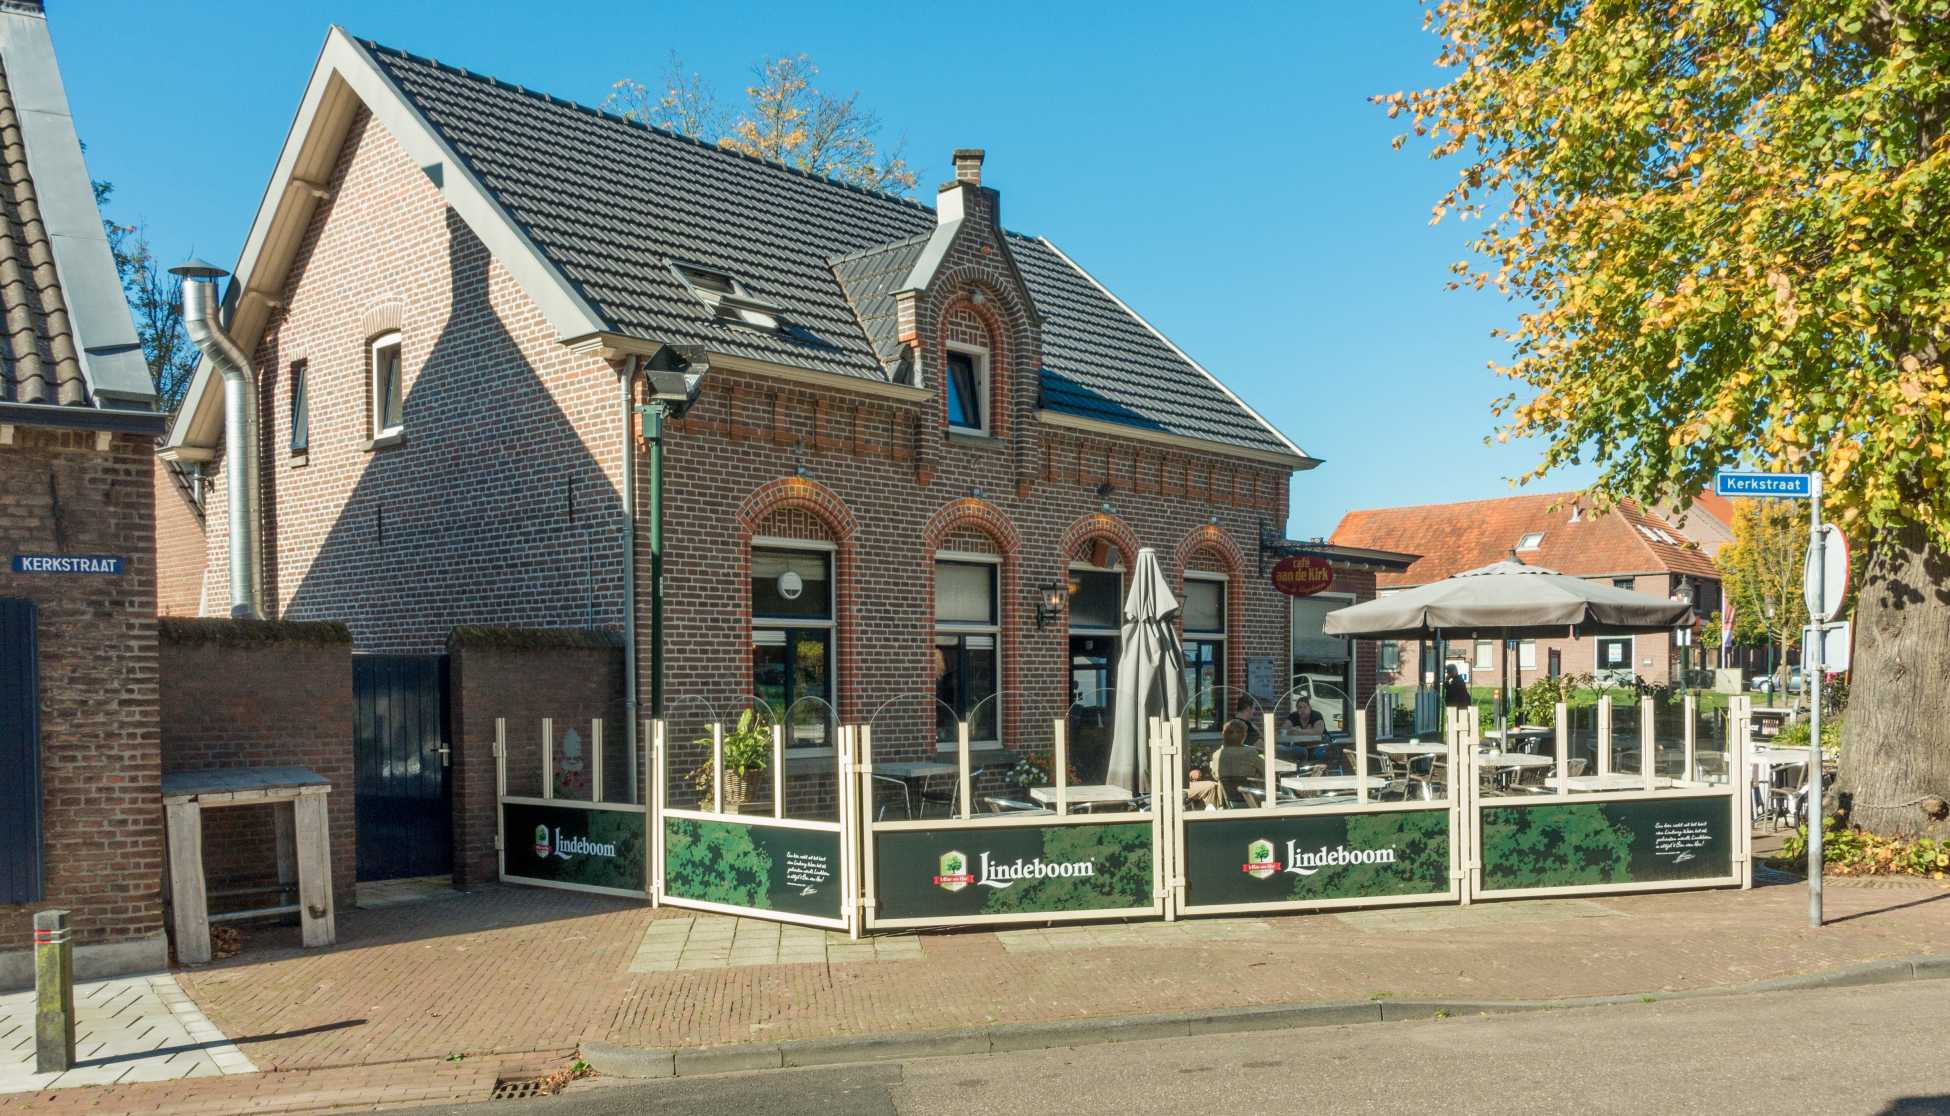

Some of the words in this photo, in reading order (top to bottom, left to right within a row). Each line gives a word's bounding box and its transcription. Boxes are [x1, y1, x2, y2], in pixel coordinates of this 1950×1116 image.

[1727, 477, 1801, 491] Kerkstraat
[22, 557, 117, 572] KERKSTRAAT
[1295, 568, 1307, 581] de
[554, 826, 617, 860] Lindeboom
[1284, 839, 1396, 876] Lindeboom
[977, 851, 1095, 889] Lindeboom
